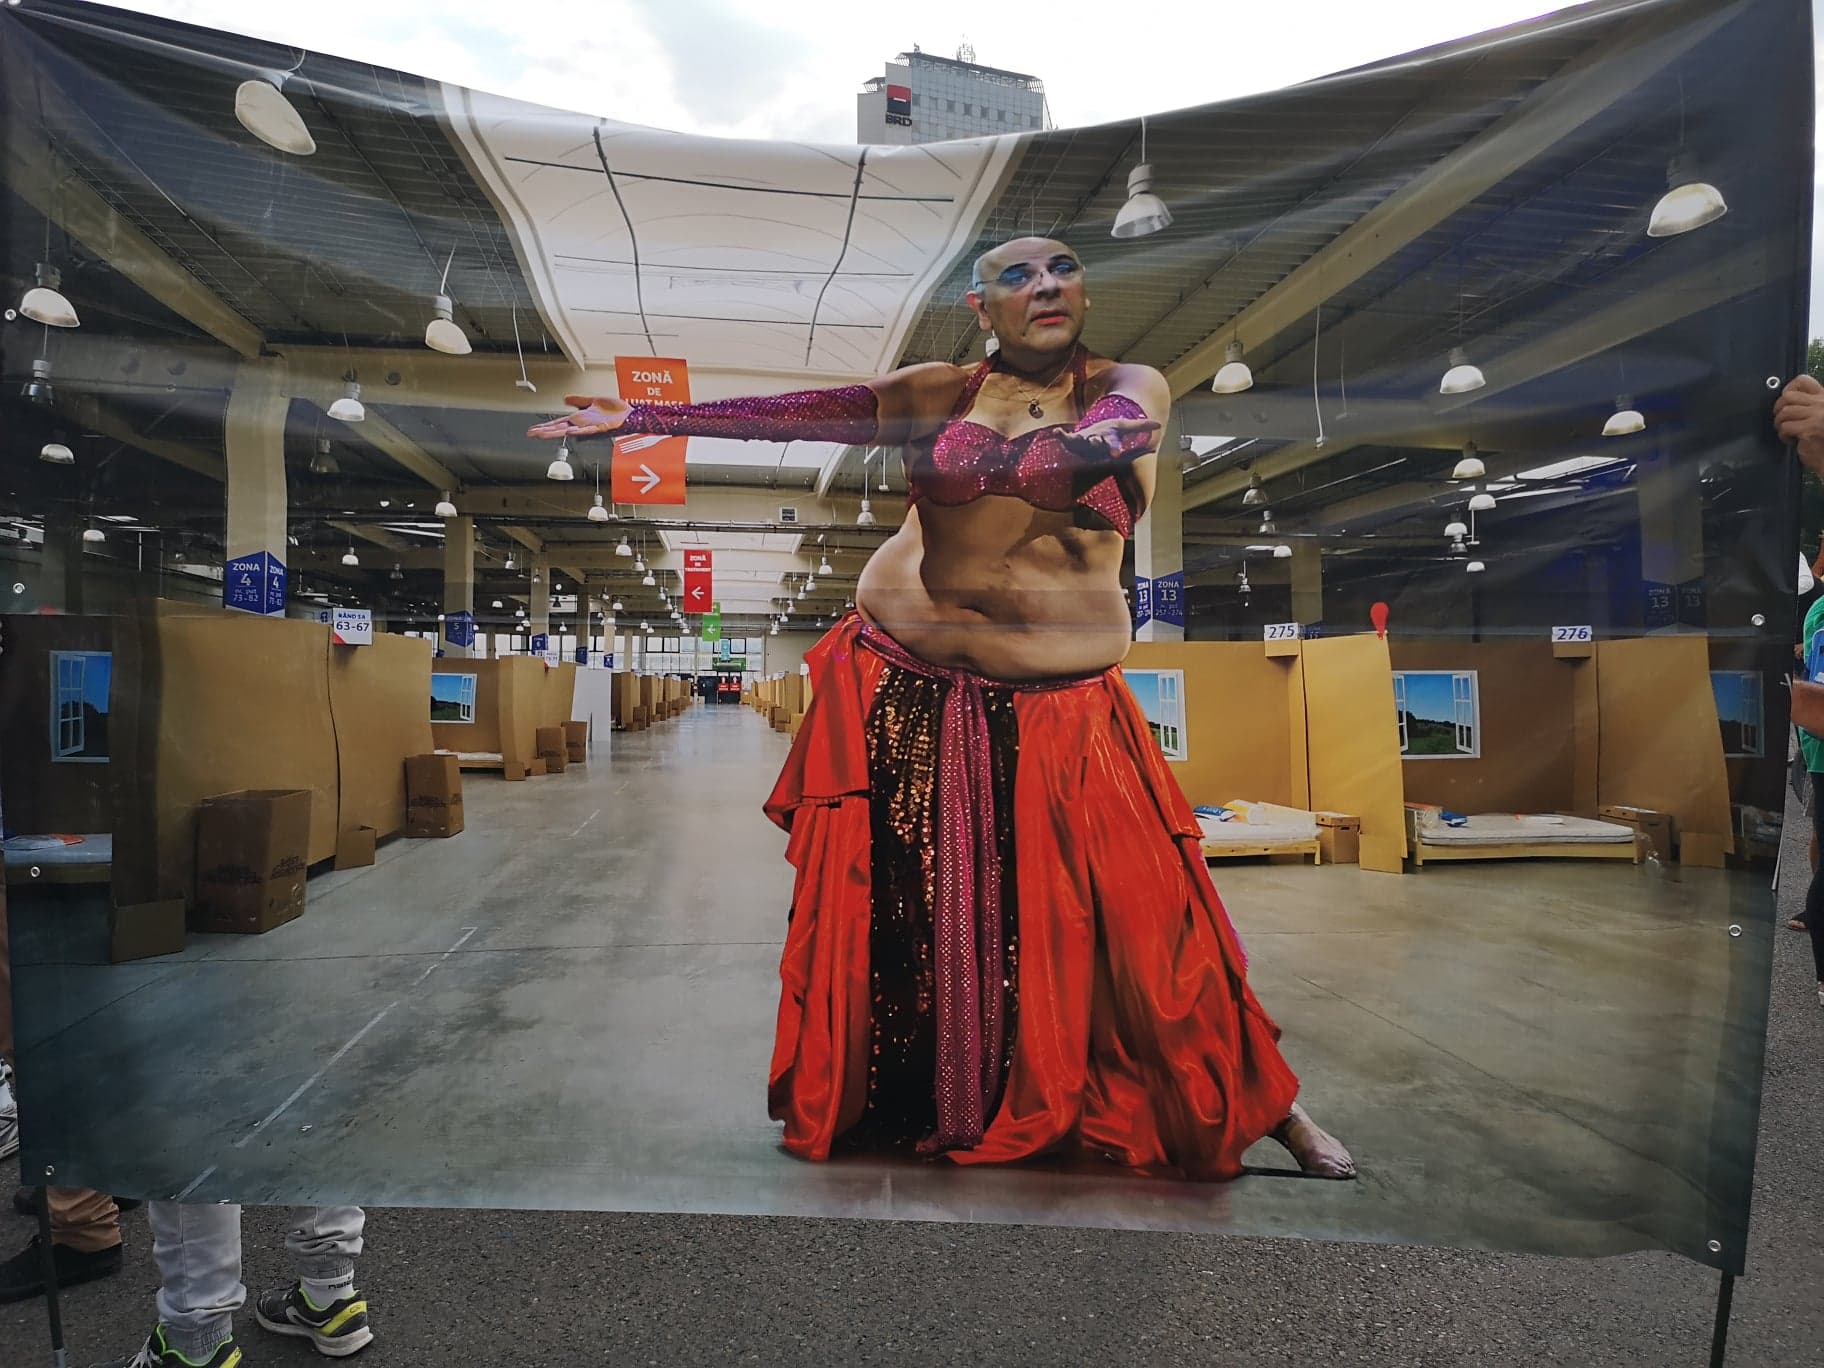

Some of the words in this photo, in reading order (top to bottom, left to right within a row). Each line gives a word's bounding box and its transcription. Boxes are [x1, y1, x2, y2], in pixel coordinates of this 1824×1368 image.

[885, 114, 912, 127] BRD
[631, 370, 673, 384] ZONĂ
[646, 387, 662, 397] DE
[232, 562, 260, 571] ZONA
[240, 573, 252, 586] 4
[272, 576, 279, 588] 4
[1158, 581, 1180, 589] ZONA
[1139, 590, 1148, 602] 13
[1161, 590, 1177, 601] 13
[1651, 596, 1669, 608] 13
[336, 621, 370, 631] 63-67
[1269, 625, 1295, 639] 275
[1557, 627, 1588, 640] 276
